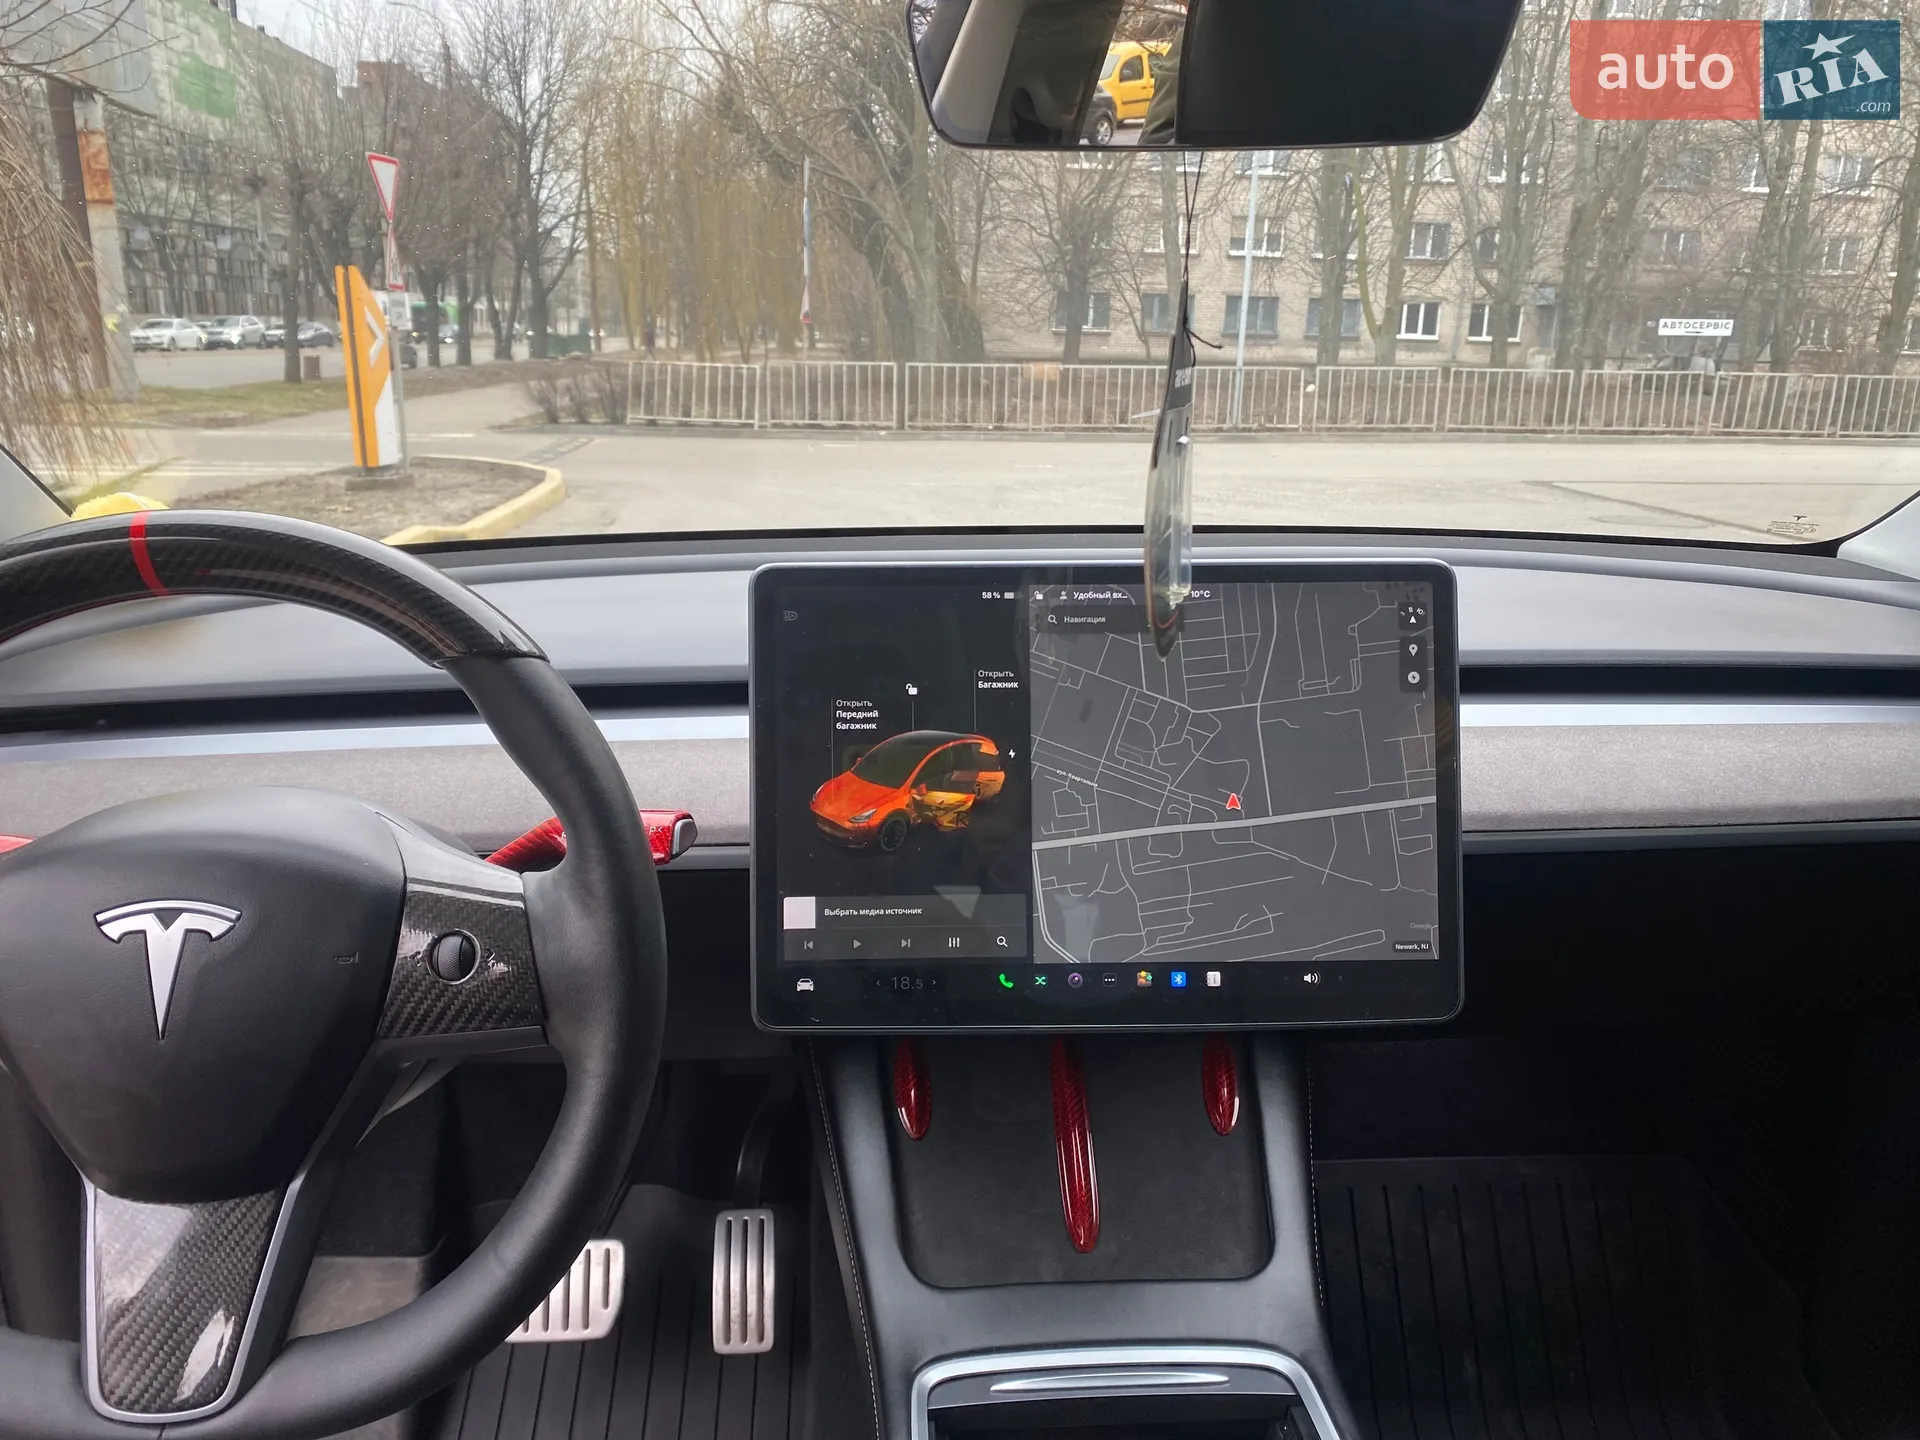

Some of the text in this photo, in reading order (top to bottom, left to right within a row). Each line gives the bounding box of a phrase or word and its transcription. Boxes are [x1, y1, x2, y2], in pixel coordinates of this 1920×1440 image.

[1662, 321, 1731, 330] АВТОСЕРВІС
[982, 591, 992, 599] 58
[1073, 591, 1111, 600] Удобный
[1190, 590, 1211, 598] 10°C
[1063, 616, 1106, 624] Навигация
[977, 669, 1015, 679] Открыть
[977, 680, 1019, 689] Багажник
[835, 699, 873, 708] Открыть
[835, 709, 879, 719] Передний
[835, 722, 877, 731] багажник
[824, 908, 858, 917] Выбрать
[859, 908, 884, 916] медиа
[1395, 943, 1420, 951] Newark,
[891, 976, 923, 989] 18.5
